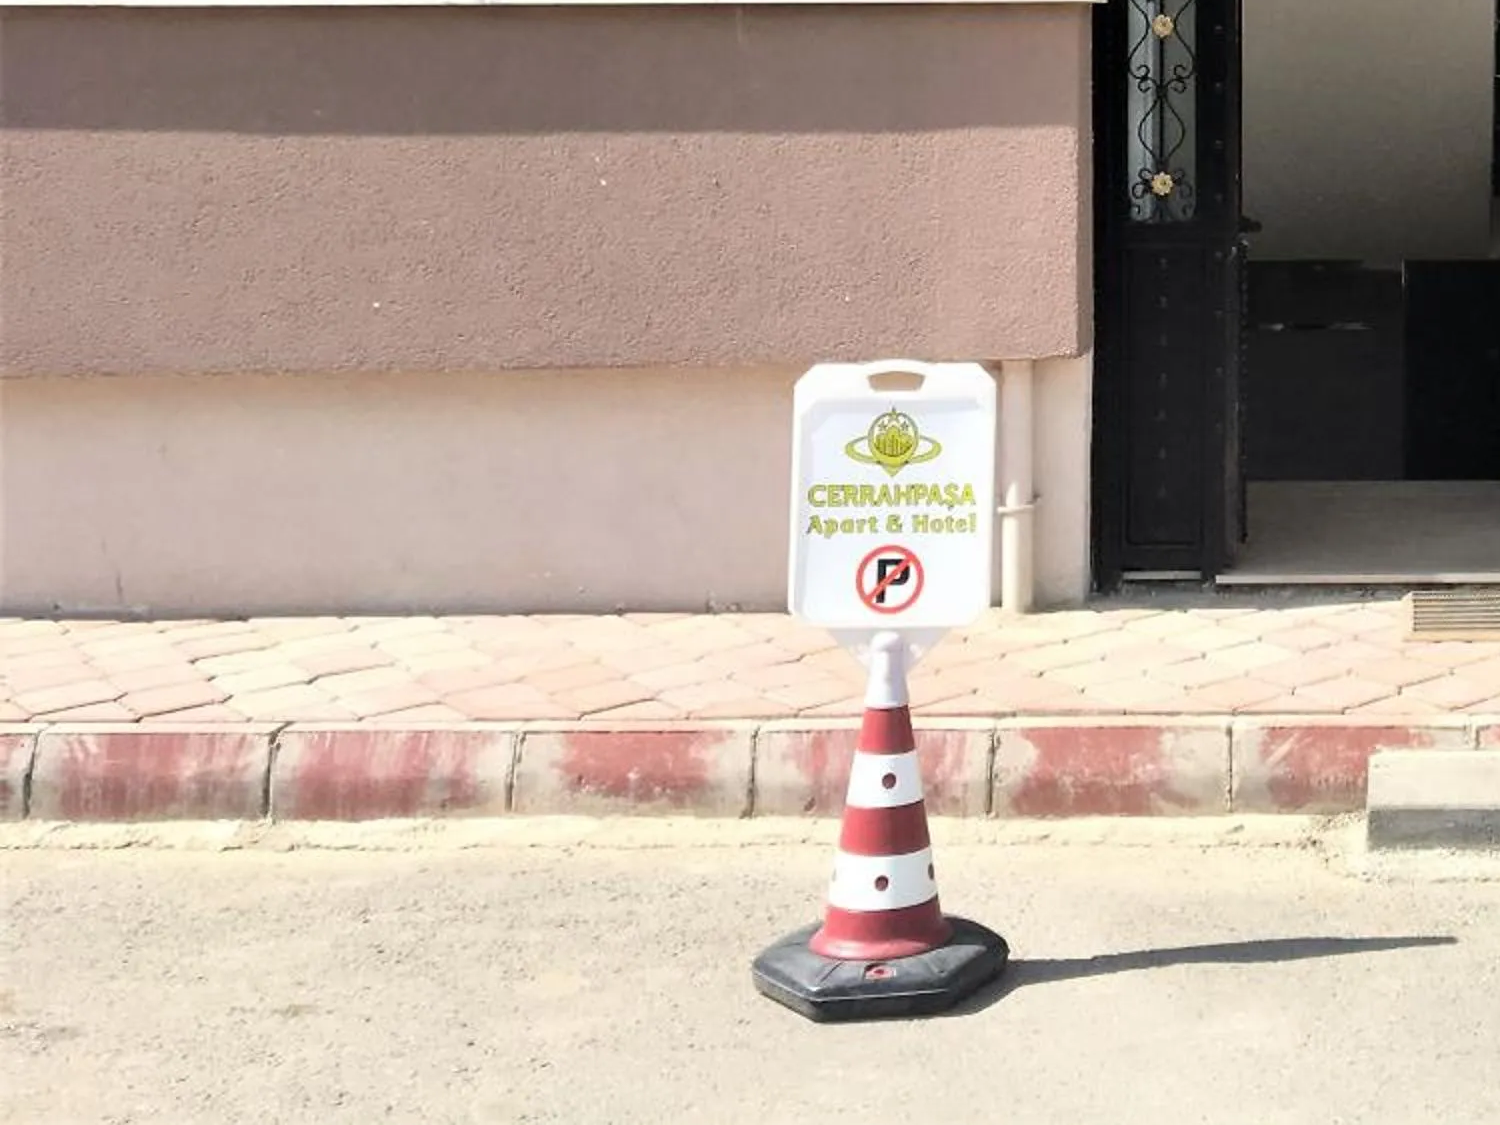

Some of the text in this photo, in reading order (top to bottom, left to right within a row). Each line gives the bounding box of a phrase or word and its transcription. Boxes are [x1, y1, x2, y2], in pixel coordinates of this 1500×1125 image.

[807, 483, 976, 511] CERRAHPAŞA
[806, 513, 977, 539] Apart & Hotel
[875, 558, 911, 604] P
